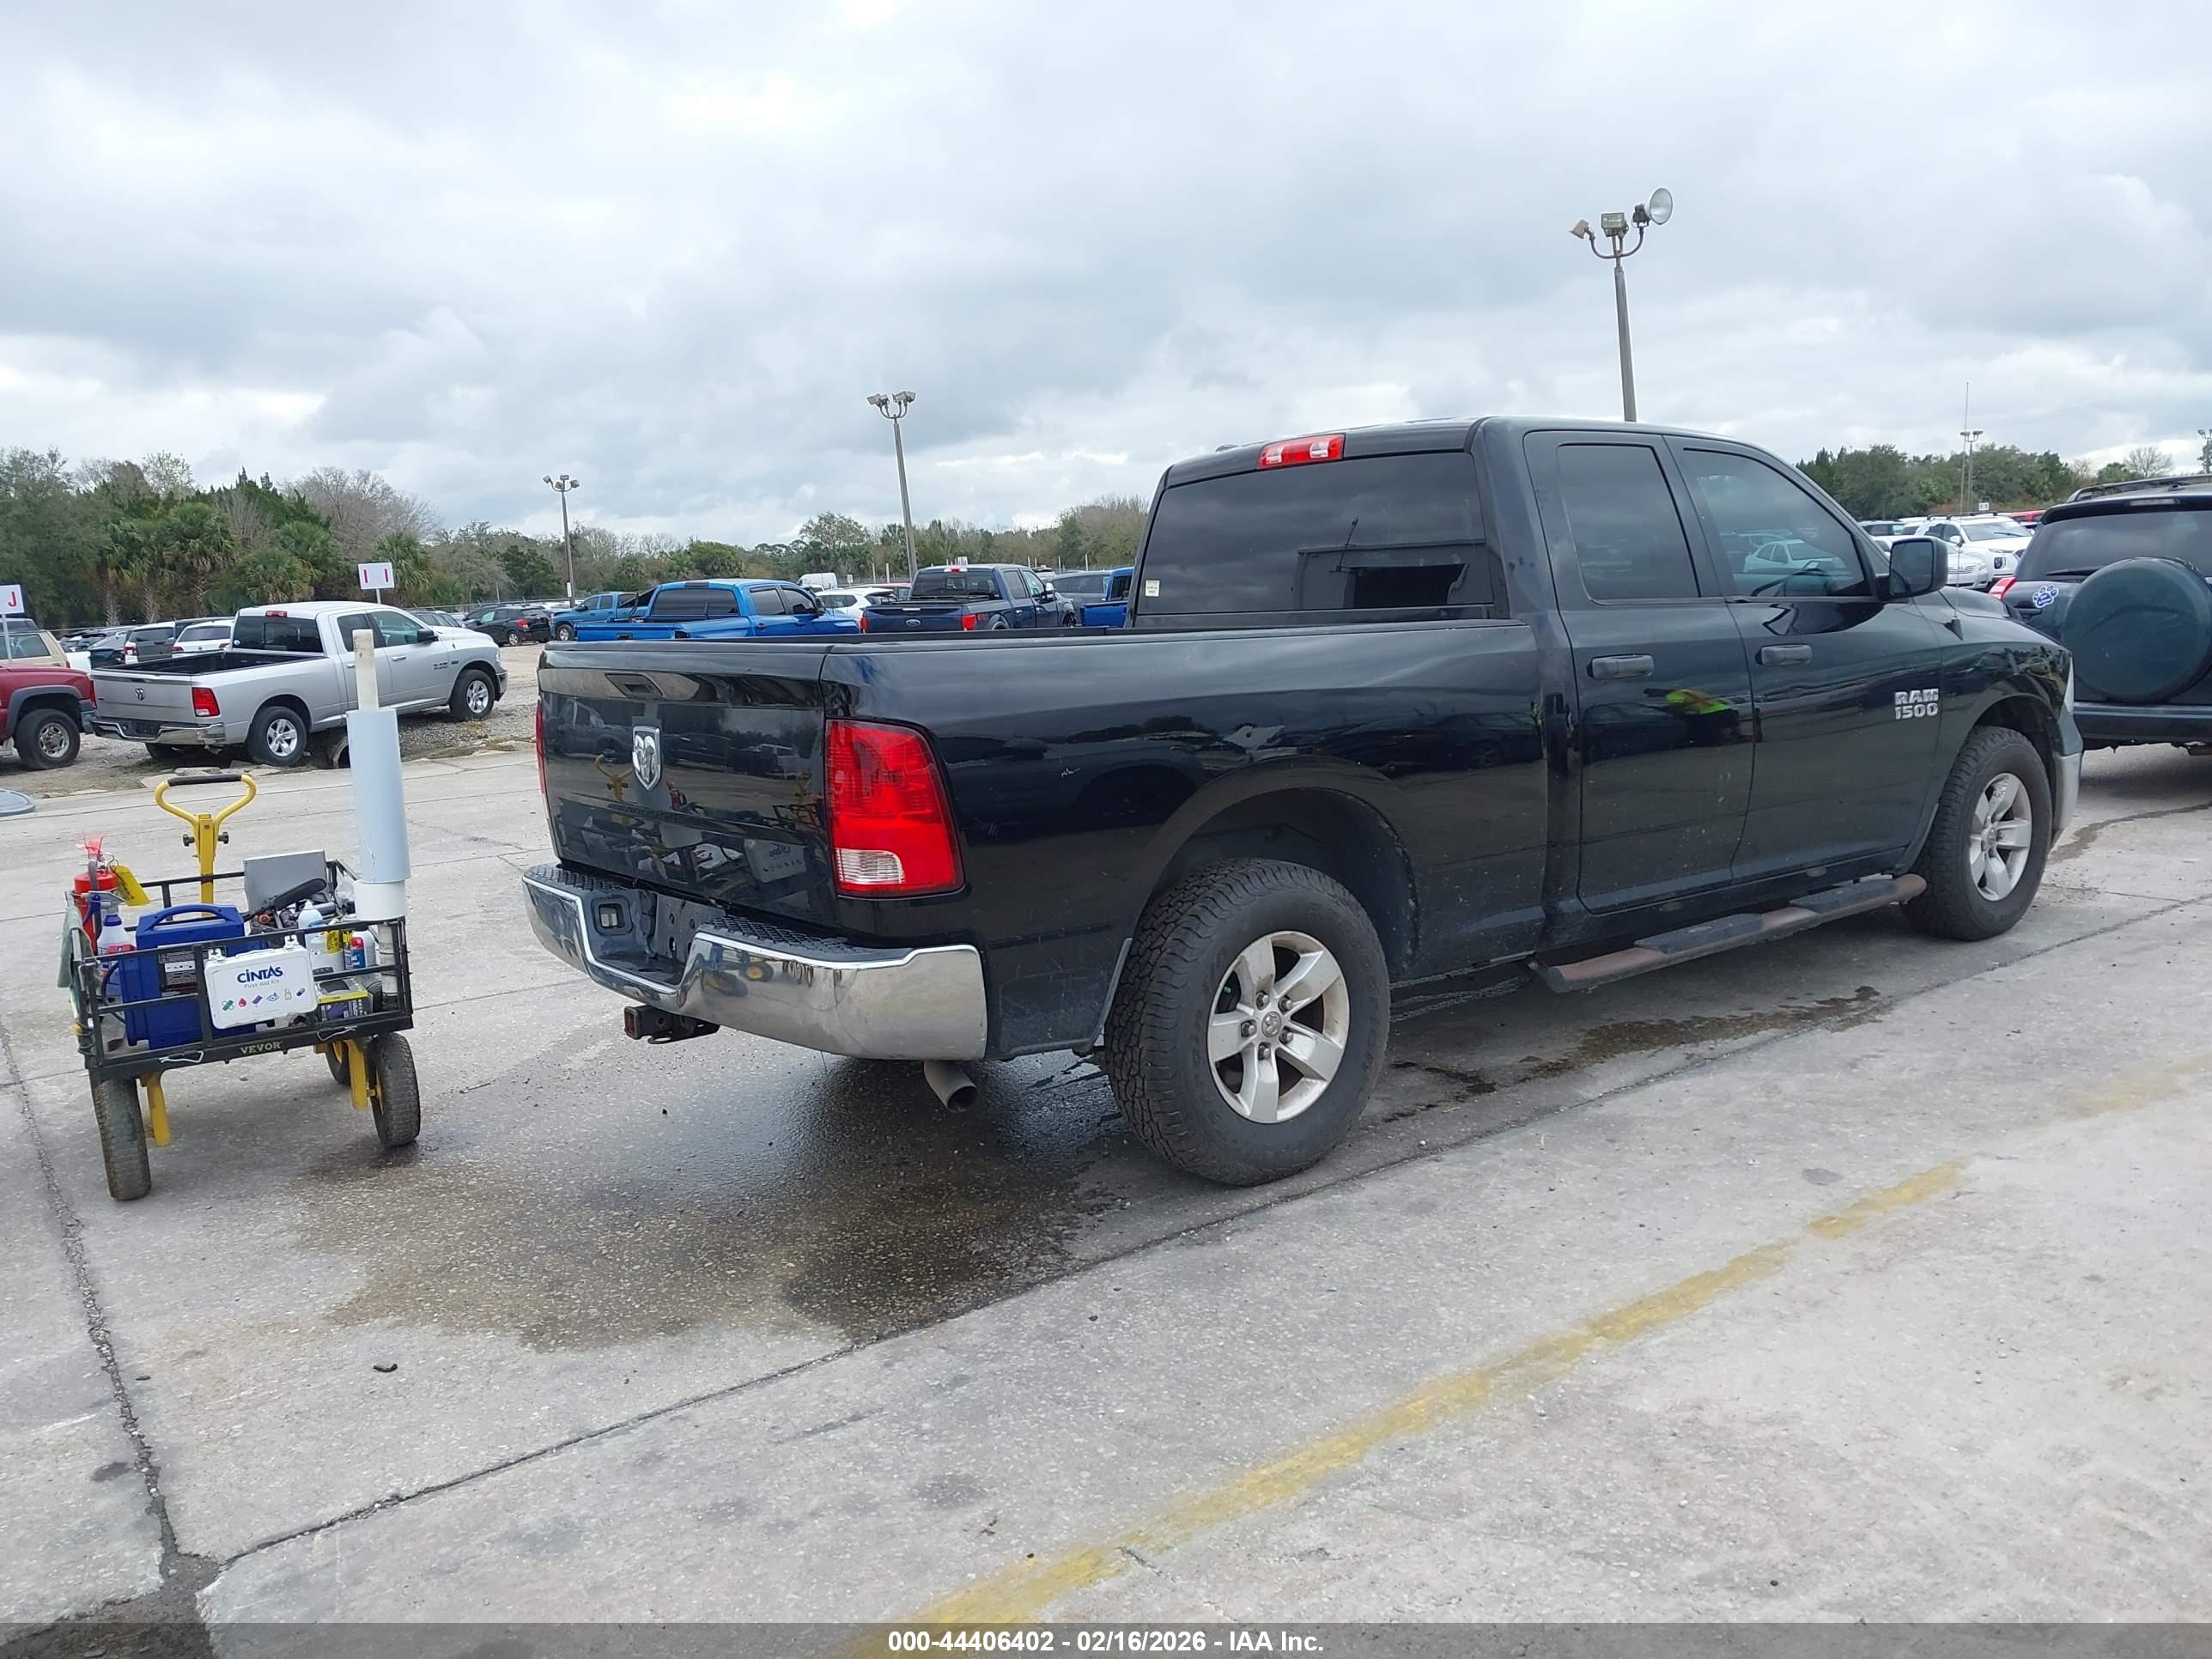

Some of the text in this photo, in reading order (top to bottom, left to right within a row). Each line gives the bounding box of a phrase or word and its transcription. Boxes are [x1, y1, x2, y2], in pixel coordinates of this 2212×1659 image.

[8, 591, 17, 607] J
[1894, 688, 1939, 705] RAM
[1894, 702, 1939, 720] 1500
[240, 1041, 283, 1055] VEVOR
